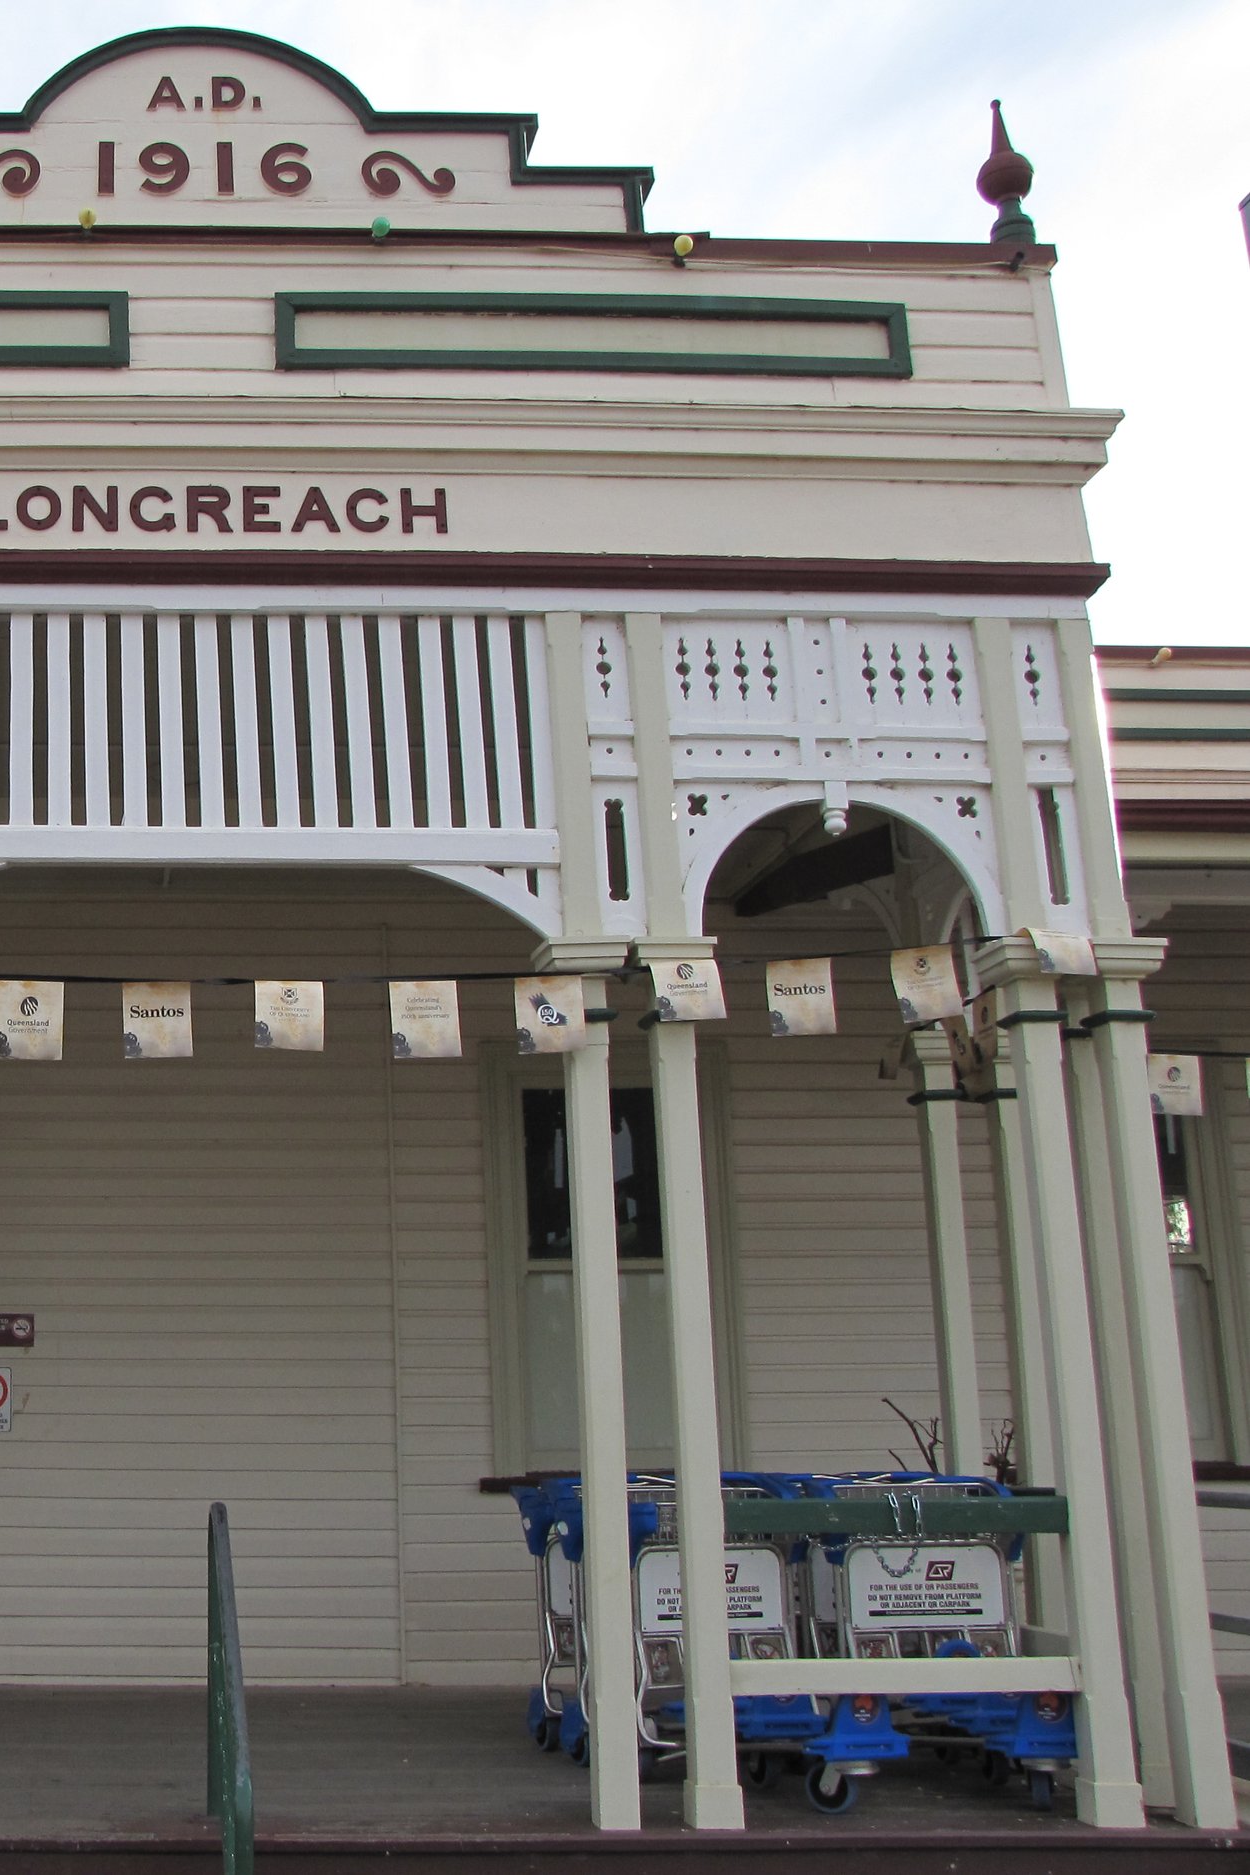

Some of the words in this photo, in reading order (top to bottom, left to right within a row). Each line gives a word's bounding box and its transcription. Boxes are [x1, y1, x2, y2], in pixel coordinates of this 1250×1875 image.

[146, 76, 262, 111] A.D.
[97, 141, 312, 197] 1916
[666, 982, 708, 990] Queensland
[773, 982, 826, 996] Santos
[129, 1004, 185, 1019] Santos
[7, 1018, 50, 1027] Queensland
[729, 1595, 763, 1603] PLATFORM
